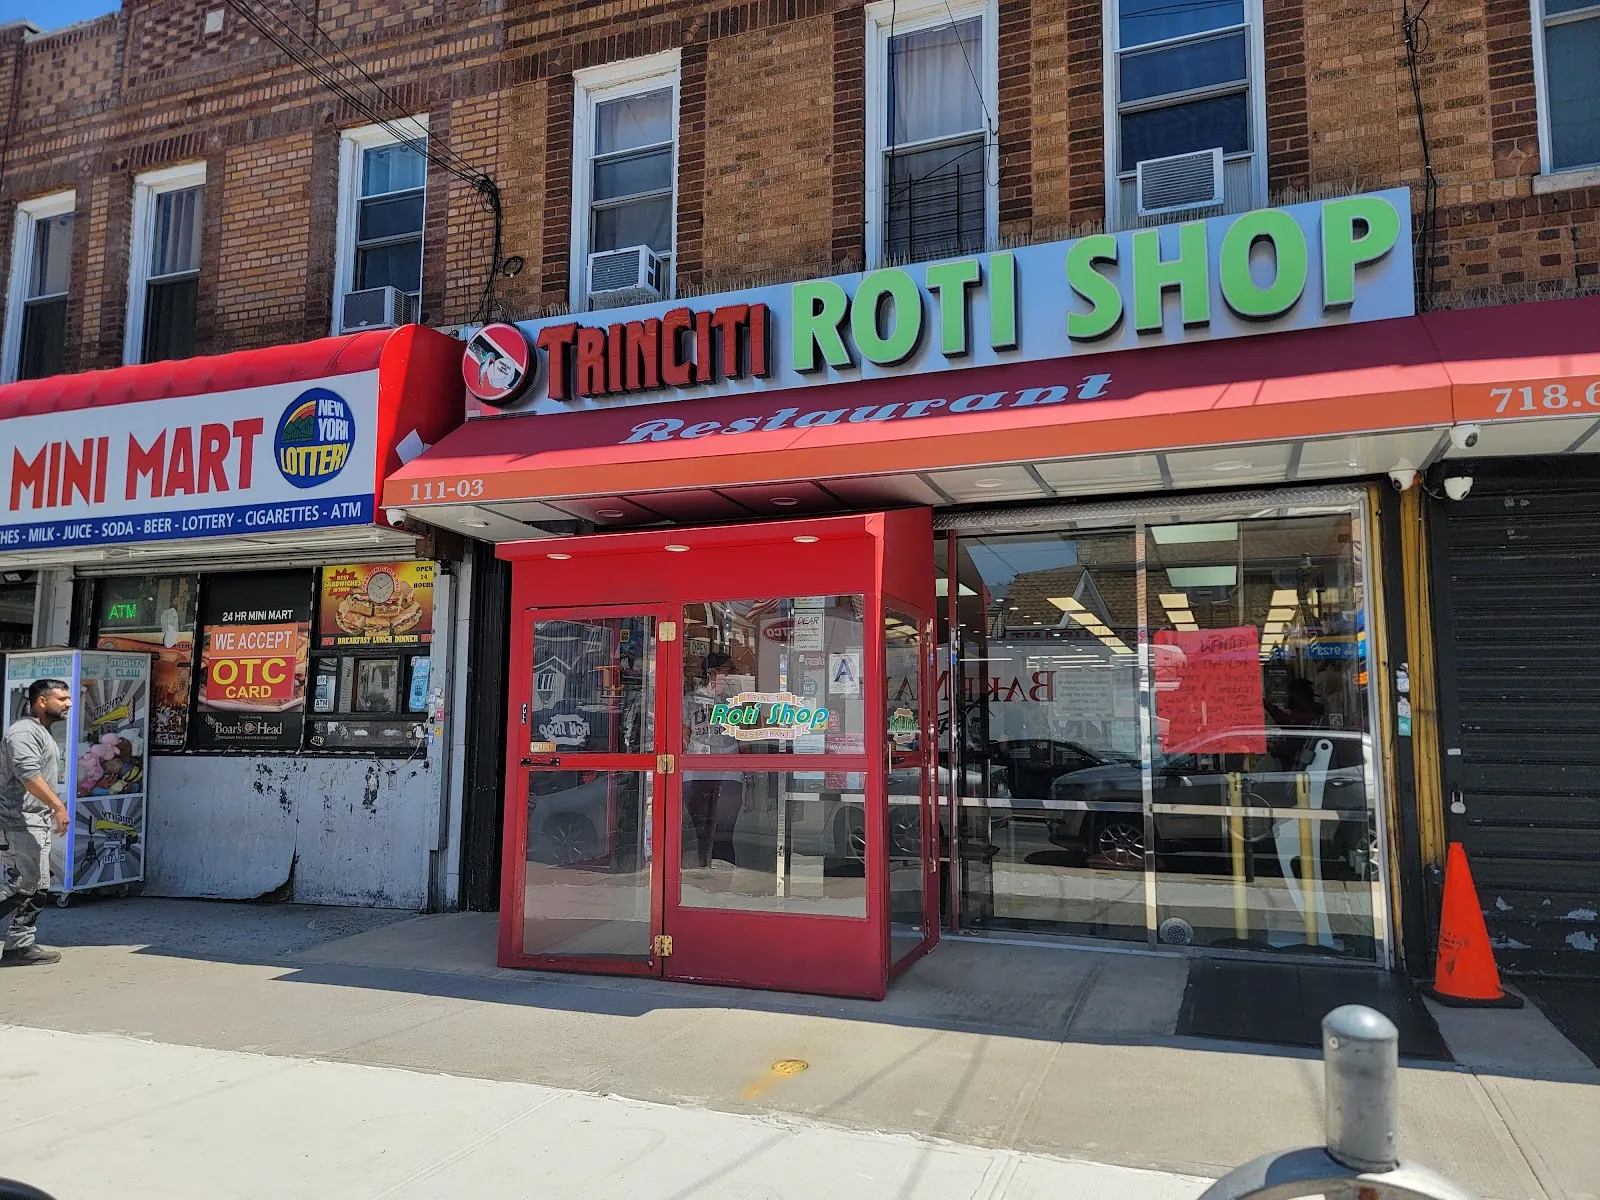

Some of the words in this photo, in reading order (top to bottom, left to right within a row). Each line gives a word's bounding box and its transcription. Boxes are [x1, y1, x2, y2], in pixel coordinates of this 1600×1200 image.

[536, 303, 770, 402] TRINCITI
[792, 251, 1018, 375] ROTI
[1064, 196, 1401, 342] SHOP
[318, 399, 344, 418] NEW
[618, 373, 1114, 444] Restaurant
[317, 417, 349, 442] YORK
[9, 436, 109, 511] MINI
[125, 417, 264, 501] MART
[280, 442, 350, 477] LOTTERY
[410, 479, 484, 501] 111-03
[28, 526, 55, 543] MILK
[63, 524, 93, 540] JUICE
[102, 521, 134, 537] SODA
[144, 518, 172, 534] BEER
[182, 513, 235, 531] LOTTERY
[245, 505, 319, 526] CIGARETTES
[330, 502, 362, 519] ATM
[323, 580, 362, 588] SANDWICHES
[108, 603, 137, 620] ATM
[222, 611, 233, 622] 24
[235, 611, 247, 621] HR
[248, 610, 267, 621] MINI
[268, 609, 293, 620] MART
[797, 616, 820, 625] DEAR
[215, 632, 236, 650] WE
[238, 630, 293, 650] ACCEPT
[395, 635, 418, 643] DINNER
[36, 657, 72, 667] MIGHTY
[110, 657, 146, 668] MIGHTY
[212, 658, 287, 685] OTC
[834, 658, 854, 682] A
[115, 668, 140, 677] CLAW
[225, 686, 272, 699] CARD
[94, 694, 126, 718] MIGHTY
[710, 703, 761, 725] Roti
[766, 703, 830, 729] Shop
[215, 721, 242, 734] Boar's
[257, 722, 283, 735] Head
